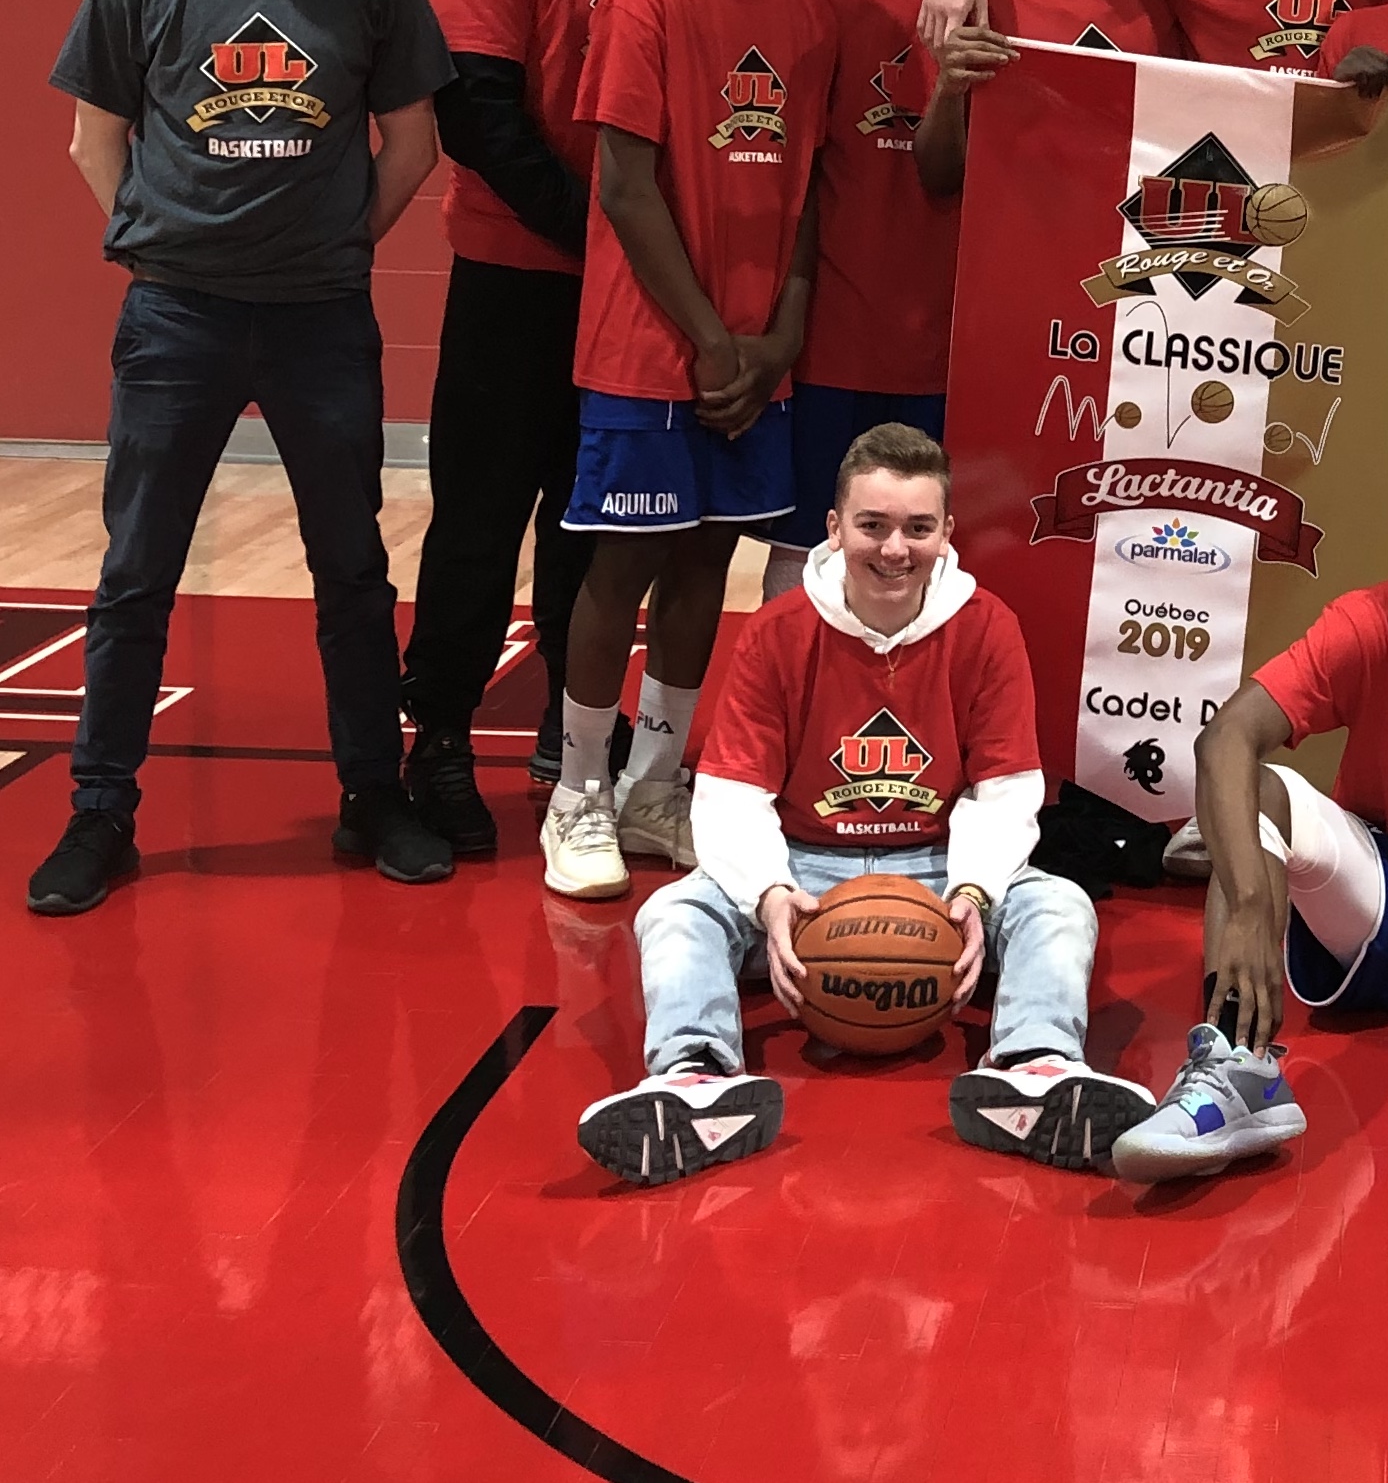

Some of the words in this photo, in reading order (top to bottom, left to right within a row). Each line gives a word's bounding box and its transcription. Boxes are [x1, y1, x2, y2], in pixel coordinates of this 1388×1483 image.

[1264, 31, 1313, 47] ROUGE
[211, 42, 307, 84] UL
[202, 91, 265, 115] ROUGE
[268, 91, 290, 104] ET
[291, 96, 318, 112] OR
[728, 71, 784, 107] UL
[756, 114, 773, 126] ET
[1115, 249, 1209, 280] Rouge
[1212, 257, 1248, 273] et
[1246, 268, 1275, 292] Or
[1048, 319, 1099, 362] La
[1121, 328, 1345, 385] CLASSIQUE
[601, 492, 678, 517] AQUILON
[1080, 463, 1280, 521] Lactantia
[1130, 540, 1217, 566] parmalat
[1124, 598, 1211, 623] Québec
[1117, 619, 1211, 662] 2019
[1085, 686, 1182, 724] Cadet
[840, 736, 923, 776] UL
[830, 782, 885, 801] ROUGE
[887, 783, 909, 796] ET
[909, 787, 931, 801] OR
[836, 821, 922, 835] BASKETBALL
[826, 914, 938, 943] EVOLUTION
[821, 972, 939, 1012] Wilson
